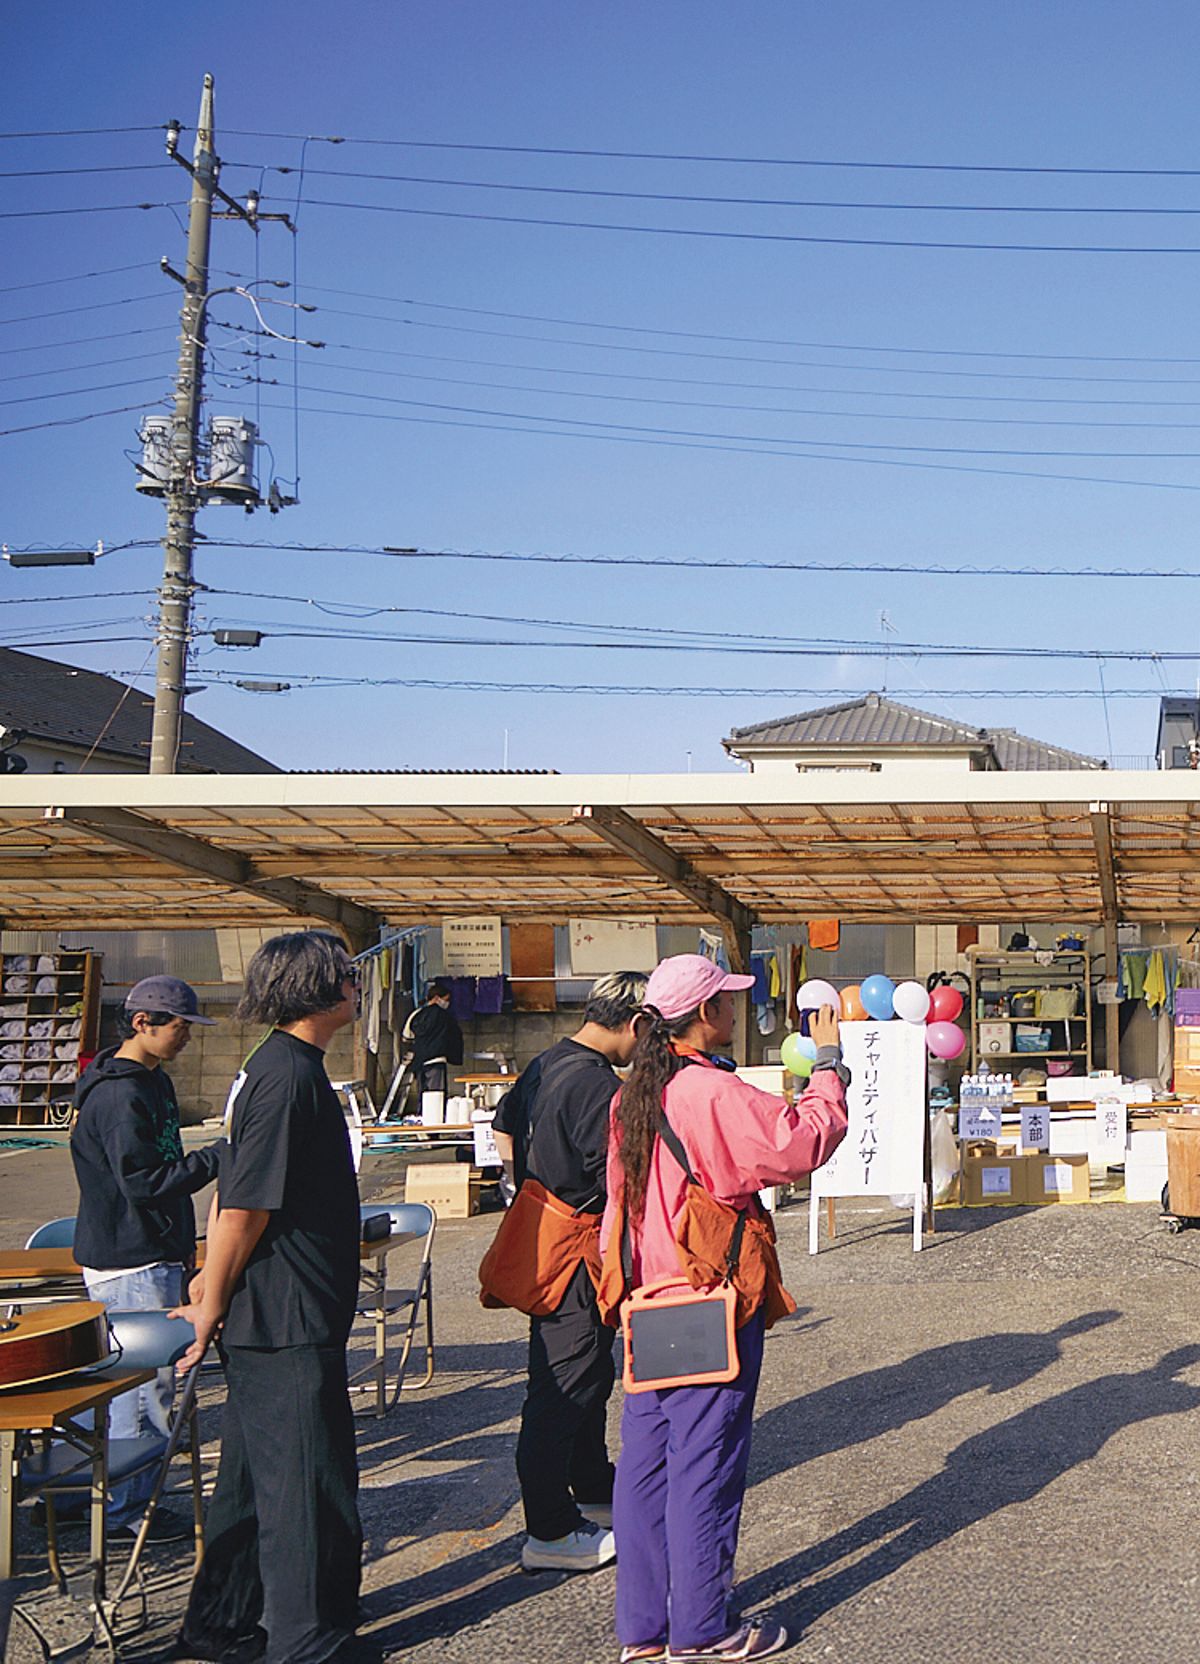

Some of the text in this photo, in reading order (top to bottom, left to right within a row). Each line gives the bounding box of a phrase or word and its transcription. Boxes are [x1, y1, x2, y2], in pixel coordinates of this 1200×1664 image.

[859, 1031, 881, 1185] チャリティバザー
[969, 1128, 993, 1137] ¥180
[1028, 1113, 1043, 1142] 本部
[1105, 1111, 1118, 1139] 受付
